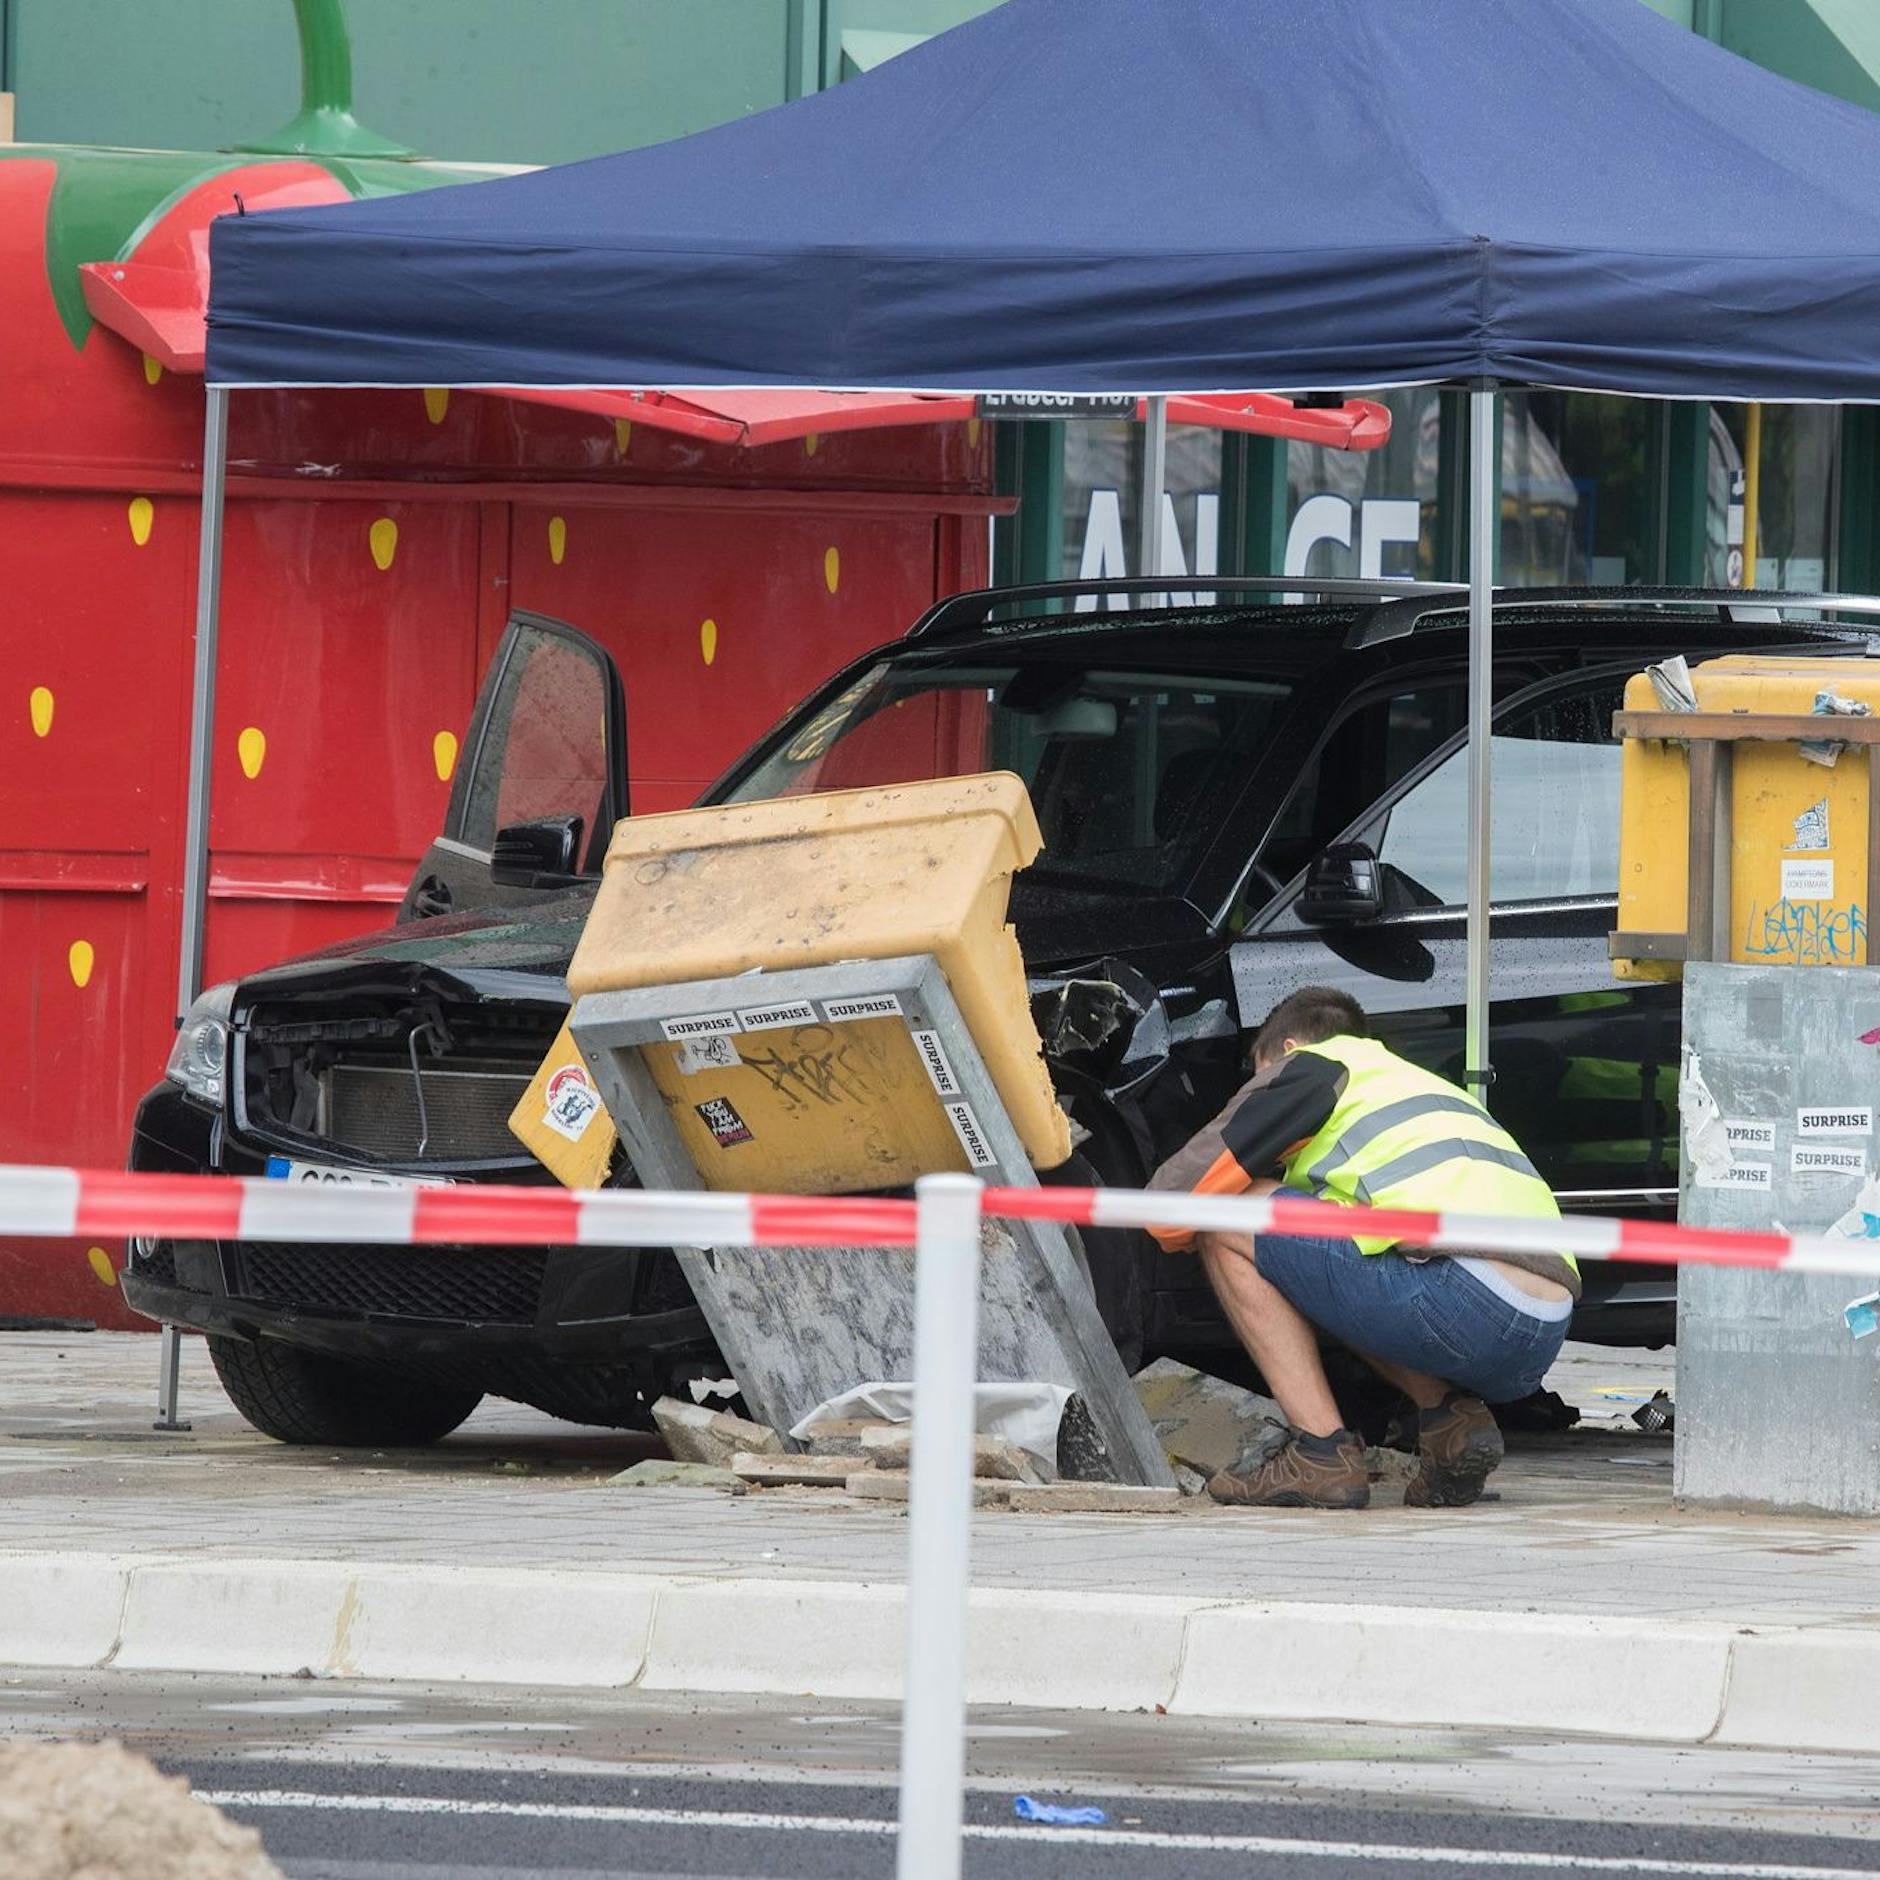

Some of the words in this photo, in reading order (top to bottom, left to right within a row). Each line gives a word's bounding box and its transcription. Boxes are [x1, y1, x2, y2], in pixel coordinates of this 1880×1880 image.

[745, 1007, 811, 1026] SURPRISE
[829, 999, 897, 1017] SURPRISE
[667, 1018, 734, 1035] SURPRISE
[920, 1034, 953, 1091] SURPRISE
[1802, 1114, 1868, 1128] SURPRISE
[953, 1106, 989, 1164] SURPRISE
[1795, 1152, 1862, 1167] SURPRISE
